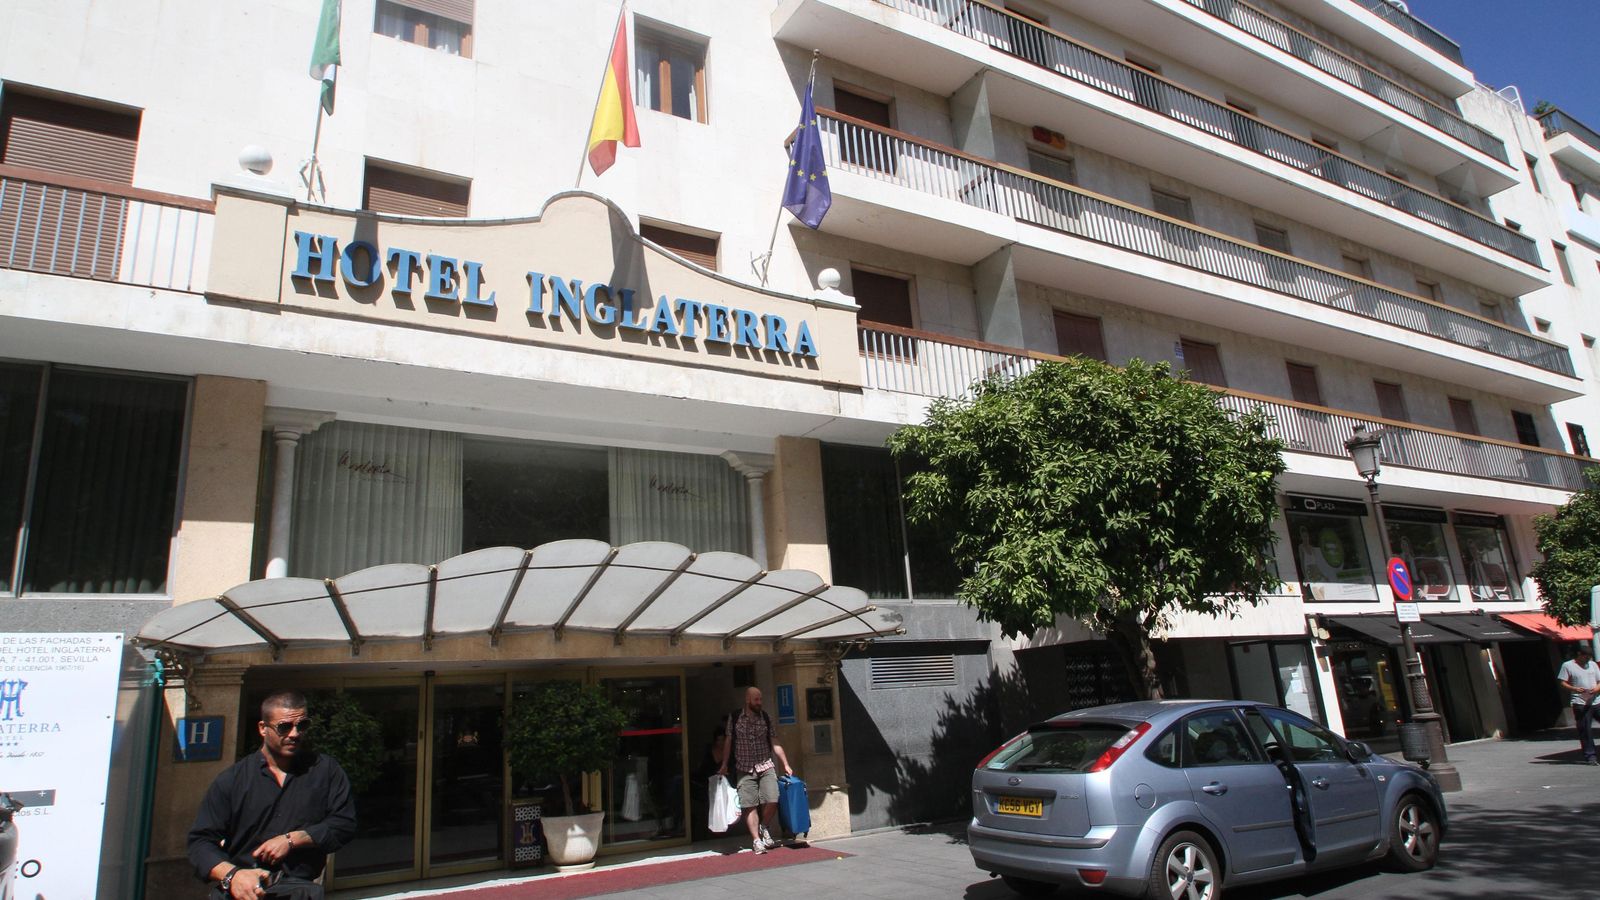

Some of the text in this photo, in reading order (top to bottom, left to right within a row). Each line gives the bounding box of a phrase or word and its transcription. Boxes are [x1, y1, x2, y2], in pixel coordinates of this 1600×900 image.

[291, 230, 819, 357] HOTEL INGLATERRA
[3, 636, 92, 645] DE LAS FACHADAS
[16, 646, 49, 654] HOTEL
[51, 646, 112, 654] INGLATERRA
[60, 655, 99, 663] SEVILLA
[188, 721, 211, 745] H
[1023, 799, 1041, 814] VGY
